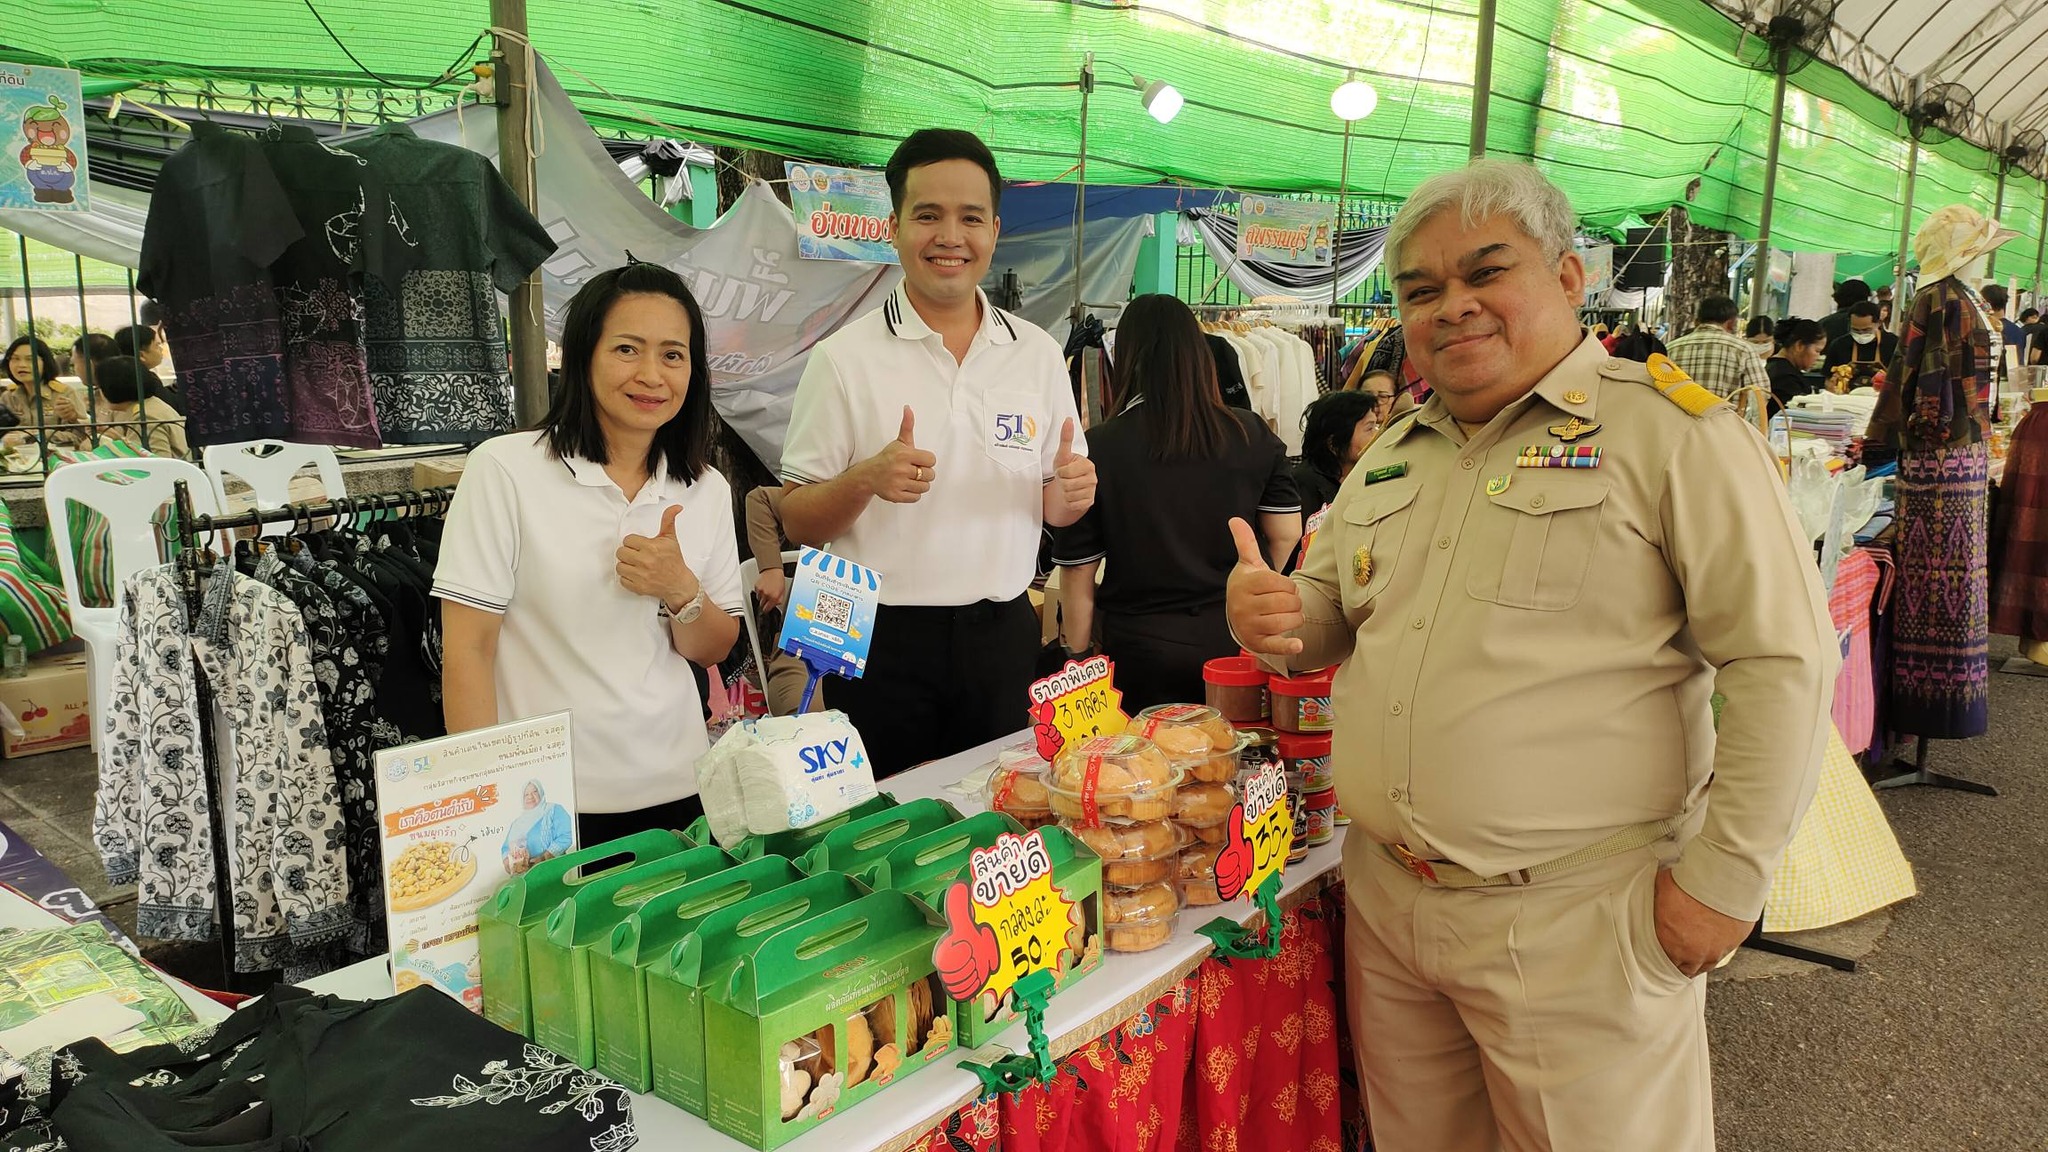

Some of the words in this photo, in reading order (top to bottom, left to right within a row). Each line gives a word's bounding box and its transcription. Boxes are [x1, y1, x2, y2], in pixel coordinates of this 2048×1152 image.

[1245, 223, 1311, 260] สุพรรณบุรี
[994, 414, 1024, 441] 51
[1034, 660, 1106, 700] ราคาพิเศษ
[799, 736, 849, 773] SKY
[1246, 767, 1285, 819] ขายดี
[1248, 765, 1273, 798] สินค้า
[399, 799, 474, 829] เราคือต้นตำรับ
[975, 838, 1021, 877] สินค้า
[976, 838, 1047, 901] ขายดี
